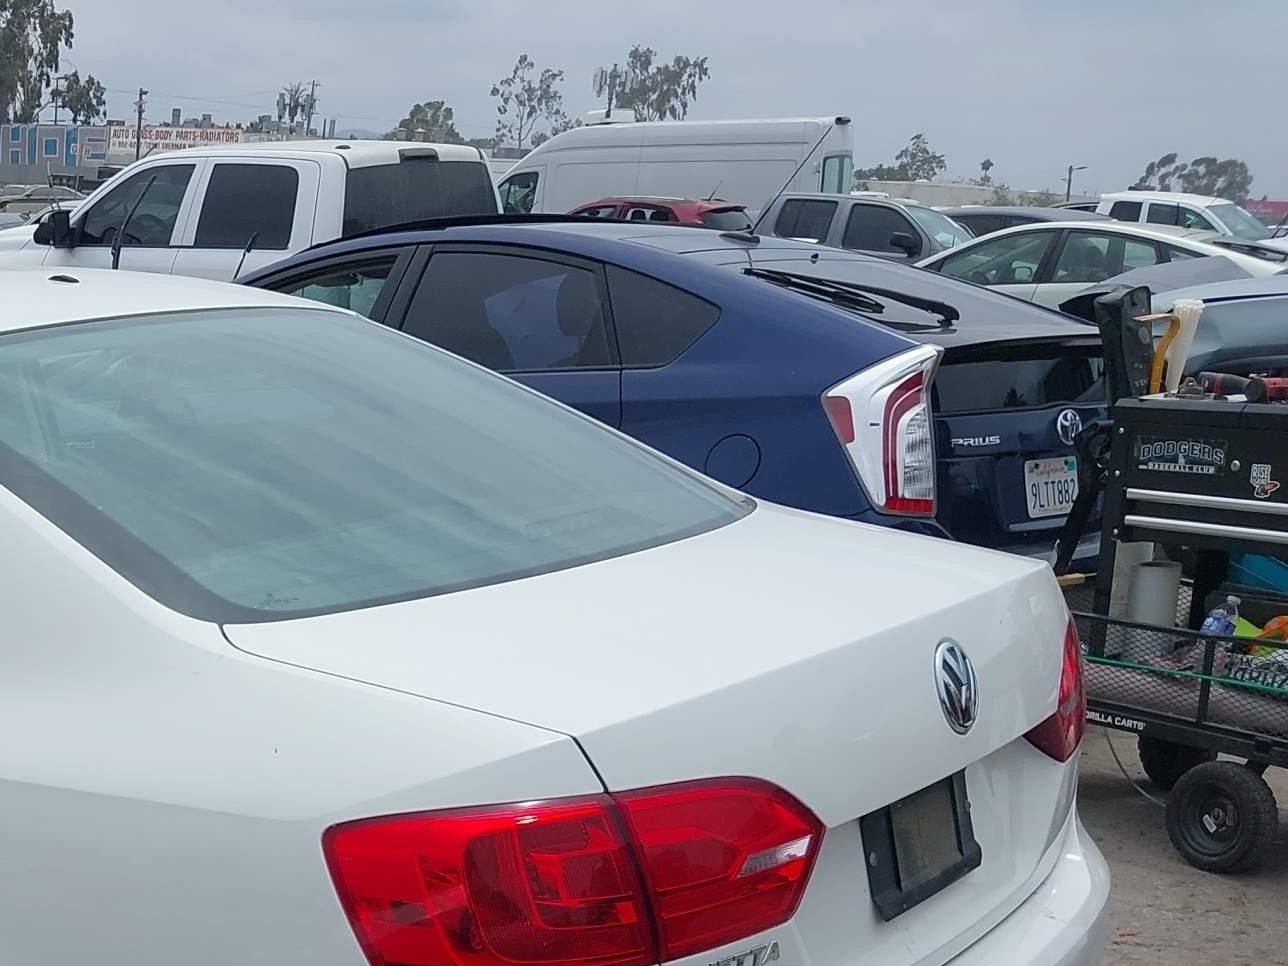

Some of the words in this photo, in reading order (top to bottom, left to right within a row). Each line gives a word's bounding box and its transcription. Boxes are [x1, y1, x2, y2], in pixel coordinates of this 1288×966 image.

[112, 128, 129, 140] AUTO
[131, 129, 173, 141] GASS-BODY
[175, 131, 240, 143] PARTS-RADIATORS
[951, 435, 1001, 448] PRIUS
[1140, 440, 1225, 465] DODGERS
[1148, 462, 1190, 473] BASEBALL
[1192, 466, 1215, 474] CLUB
[1252, 466, 1270, 479] RISE
[1031, 478, 1076, 510] 9LTT882
[1114, 716, 1144, 731] CARTS
